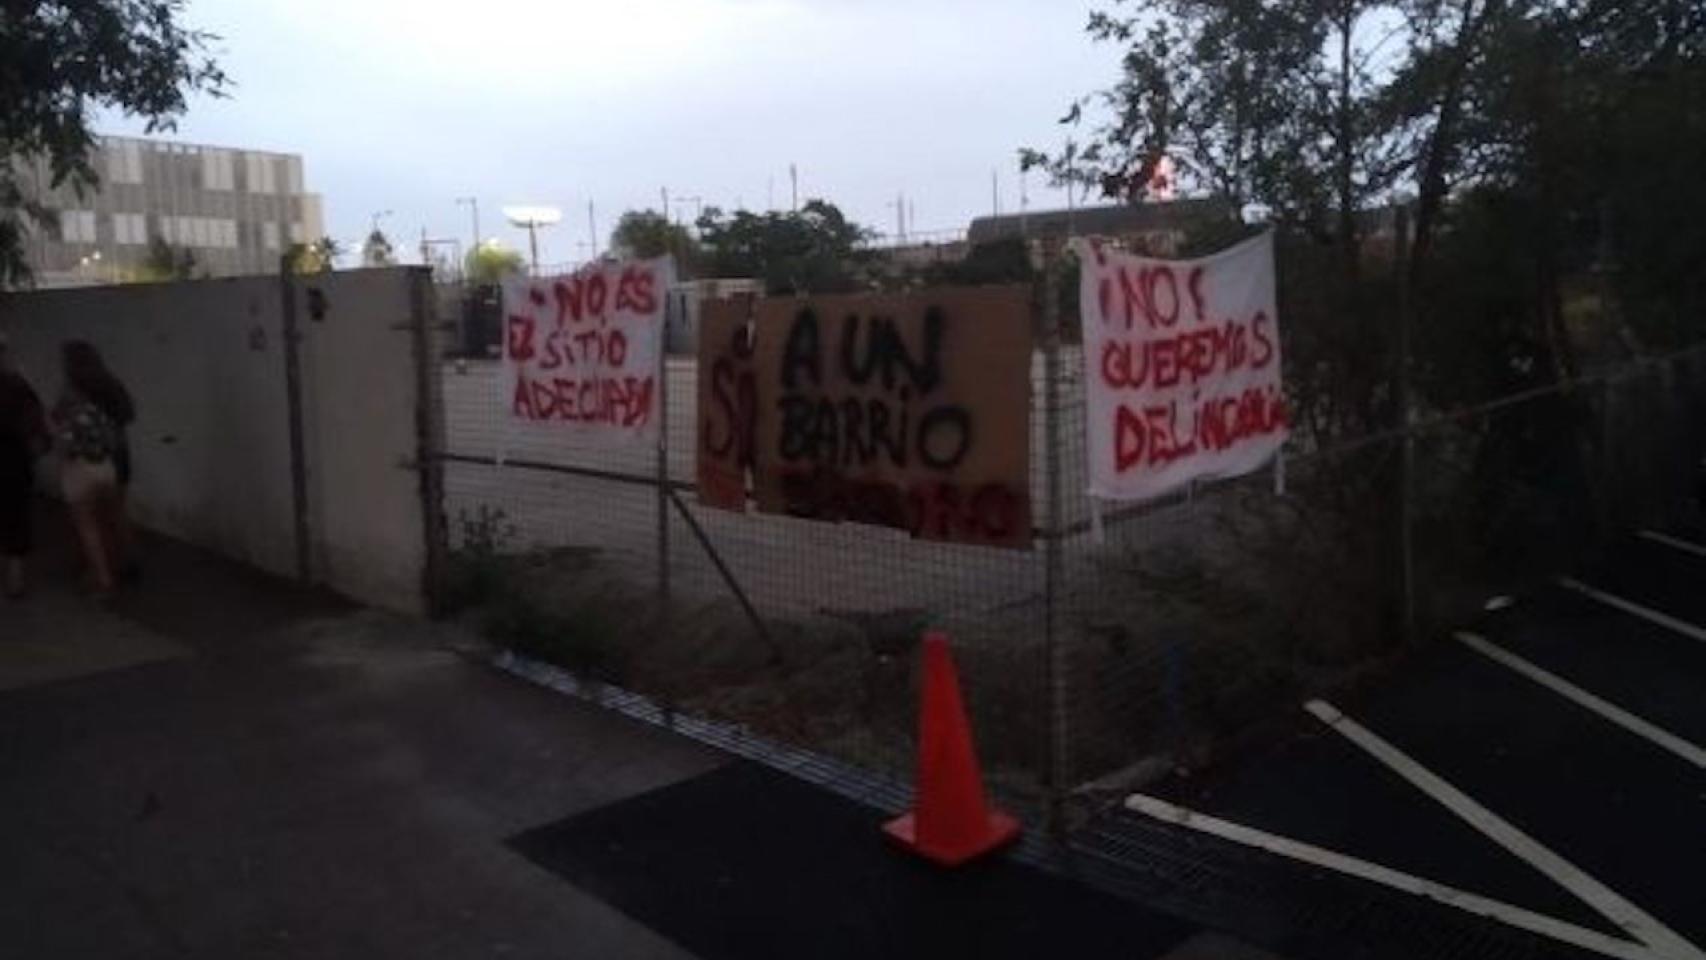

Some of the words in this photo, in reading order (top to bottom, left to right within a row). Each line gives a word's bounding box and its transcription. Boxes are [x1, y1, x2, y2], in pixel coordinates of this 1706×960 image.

[780, 308, 824, 387] A
[841, 305, 942, 395] UN
[1102, 310, 1273, 389] QUEREMOS
